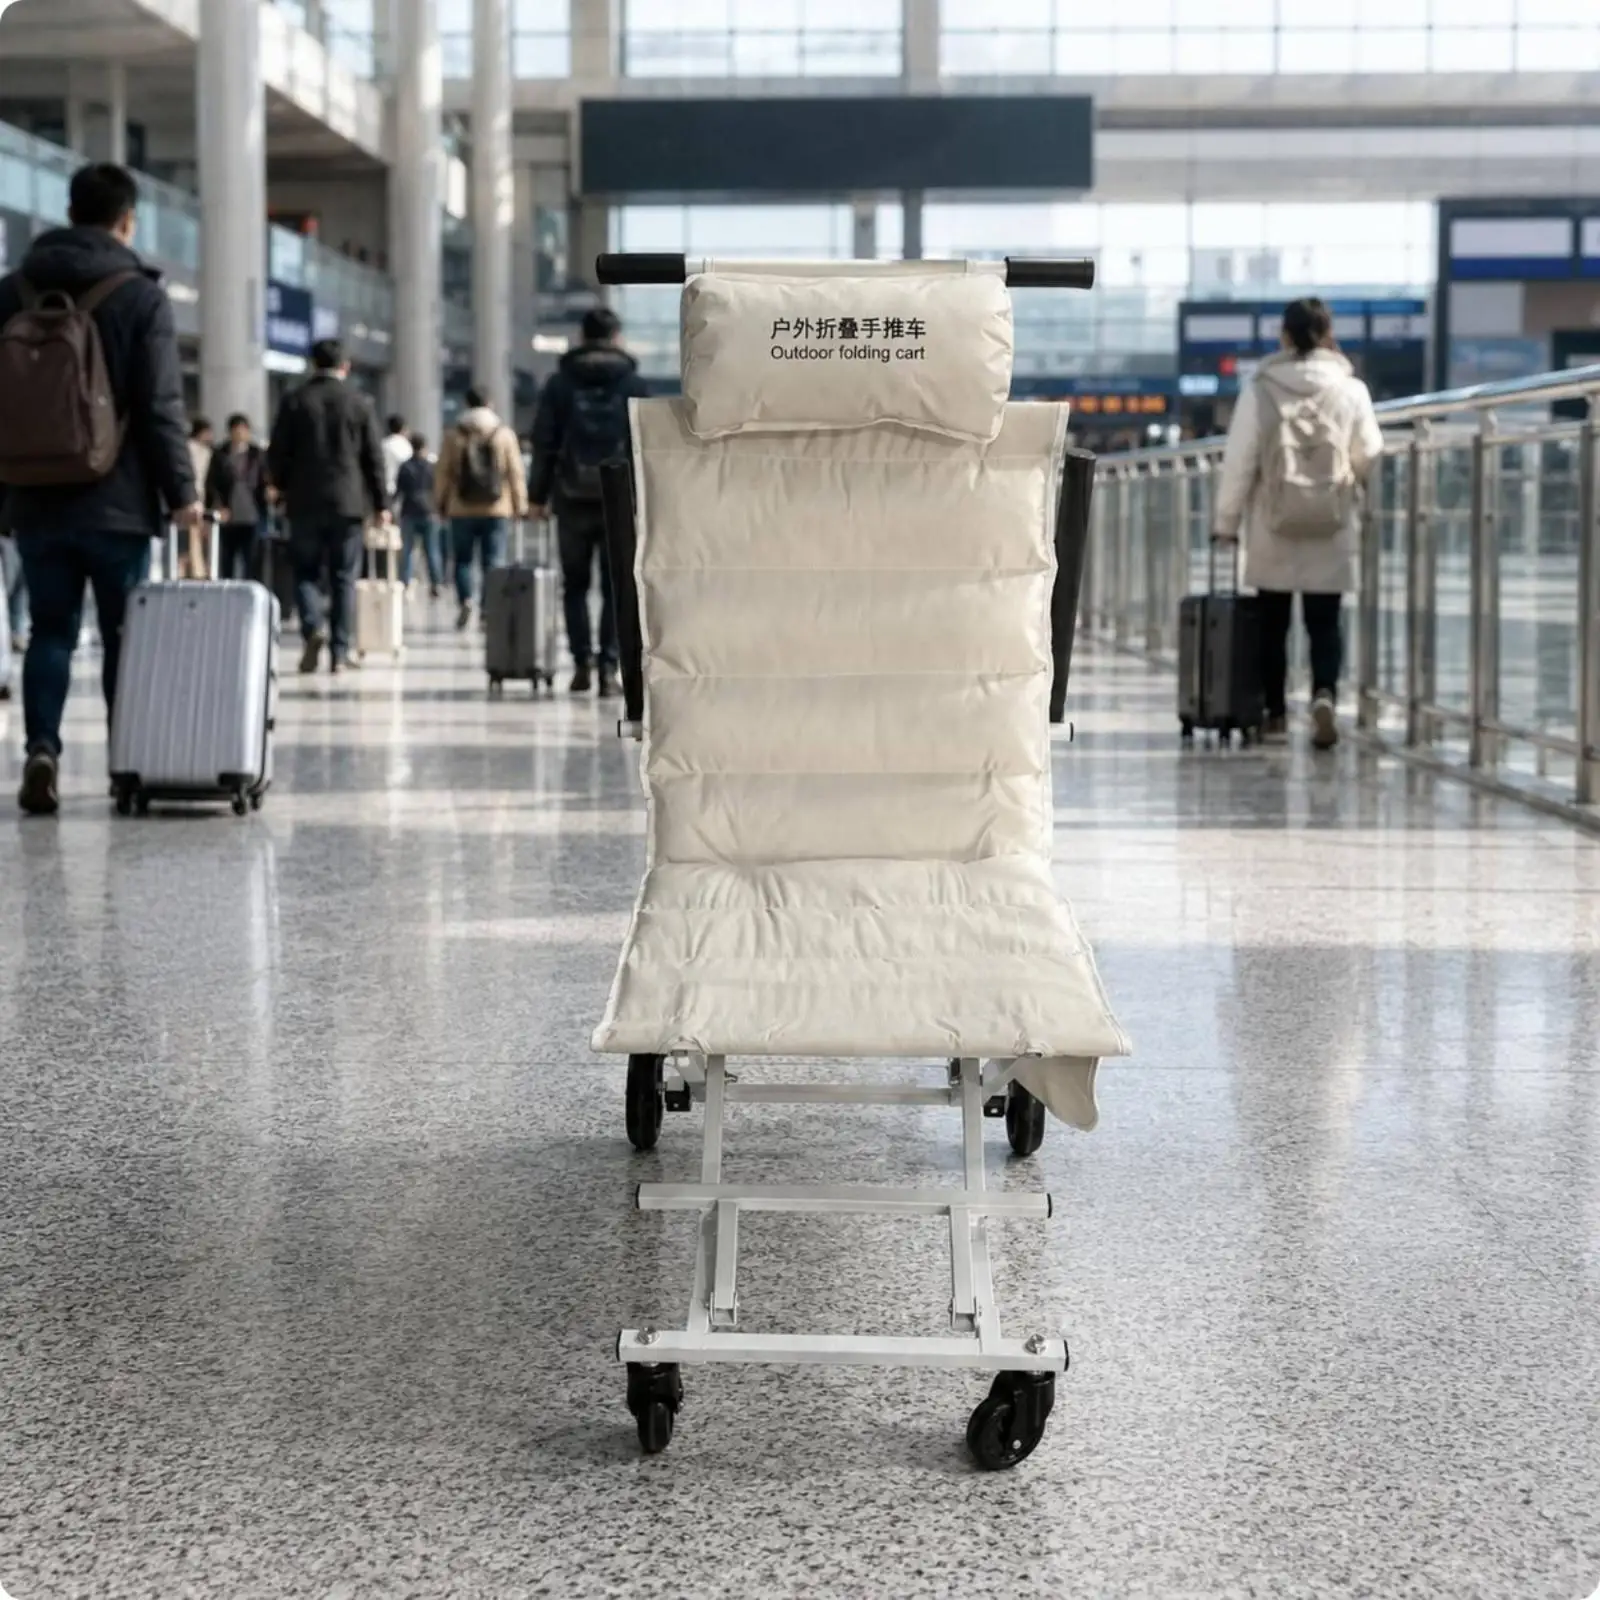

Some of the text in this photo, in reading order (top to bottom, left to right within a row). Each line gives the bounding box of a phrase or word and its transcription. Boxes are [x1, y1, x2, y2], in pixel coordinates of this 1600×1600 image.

[770, 317, 926, 340] 户外折叠手推车
[770, 345, 925, 363] Outdoor folding cart
